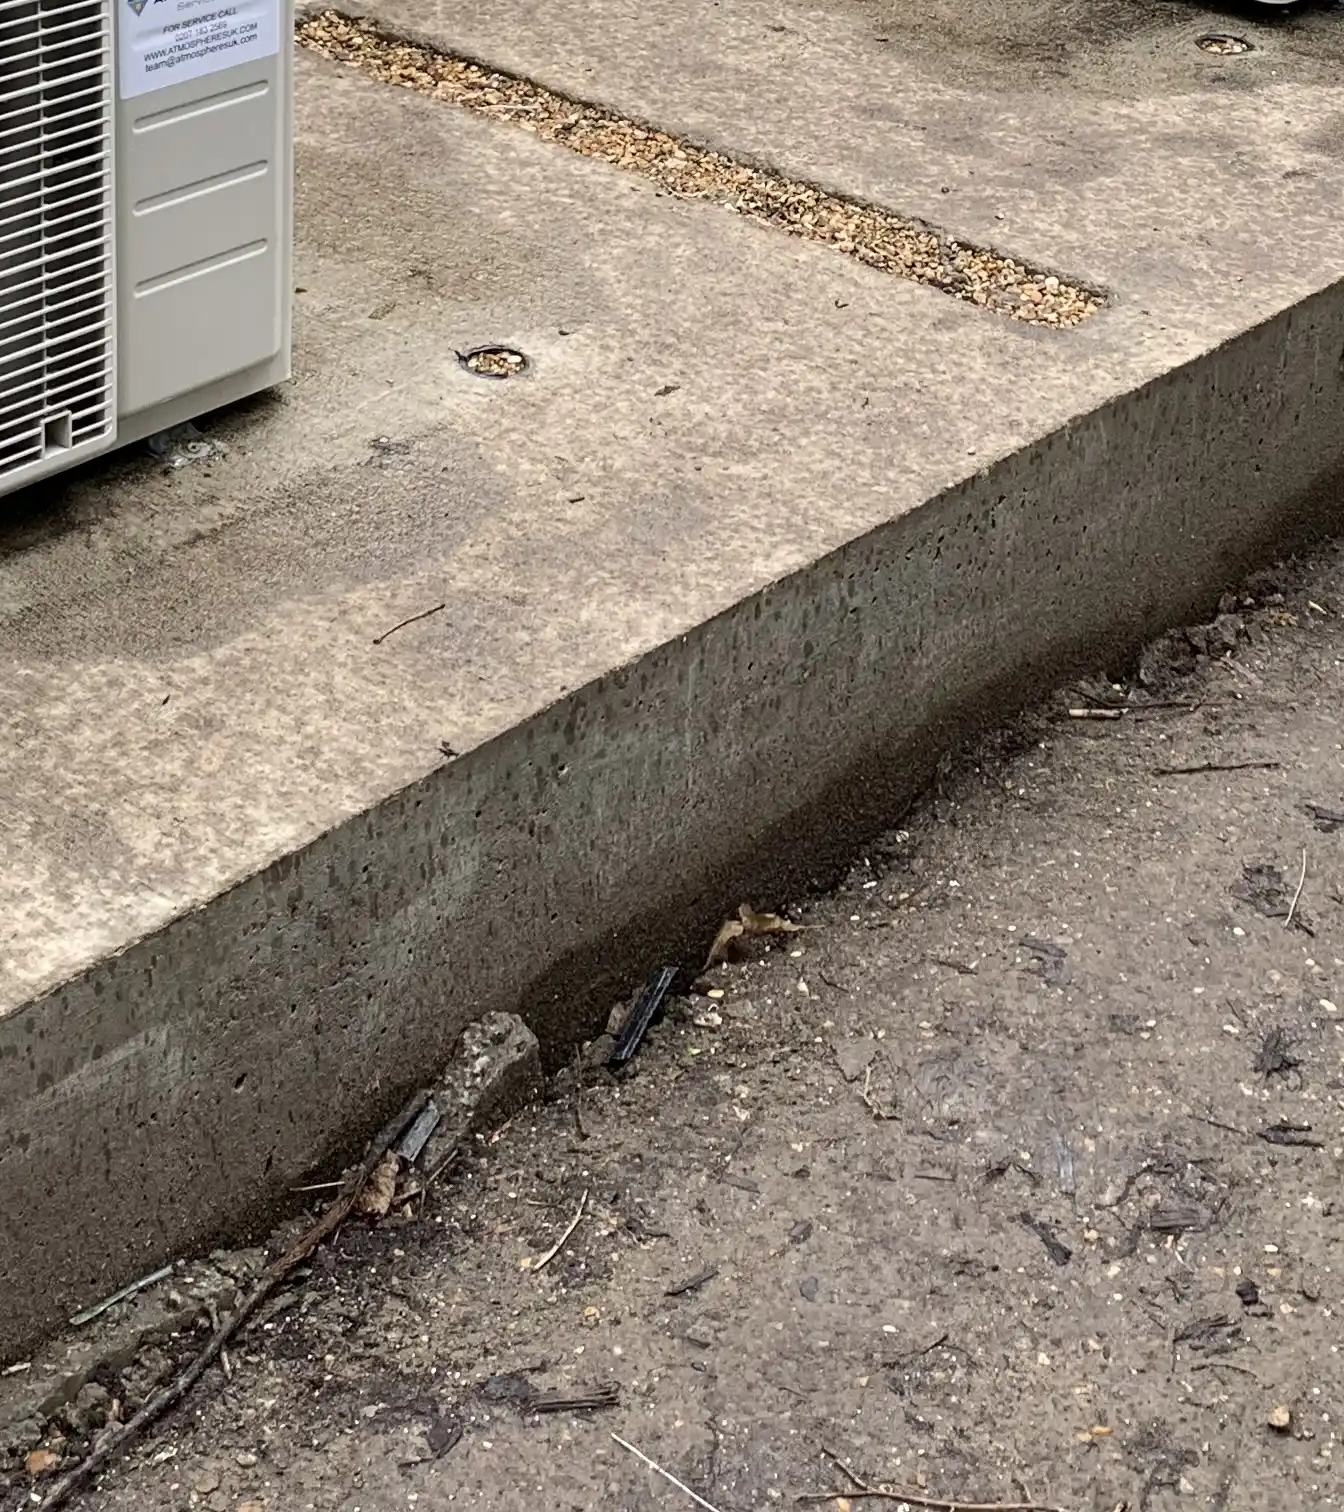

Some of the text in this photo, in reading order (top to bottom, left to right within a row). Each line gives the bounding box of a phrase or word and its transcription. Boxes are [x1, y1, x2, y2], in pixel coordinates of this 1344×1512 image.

[163, 6, 237, 34] FOR SERVICE CALL
[143, 22, 258, 61] WWW.ATMOSPHERESUK.COM
